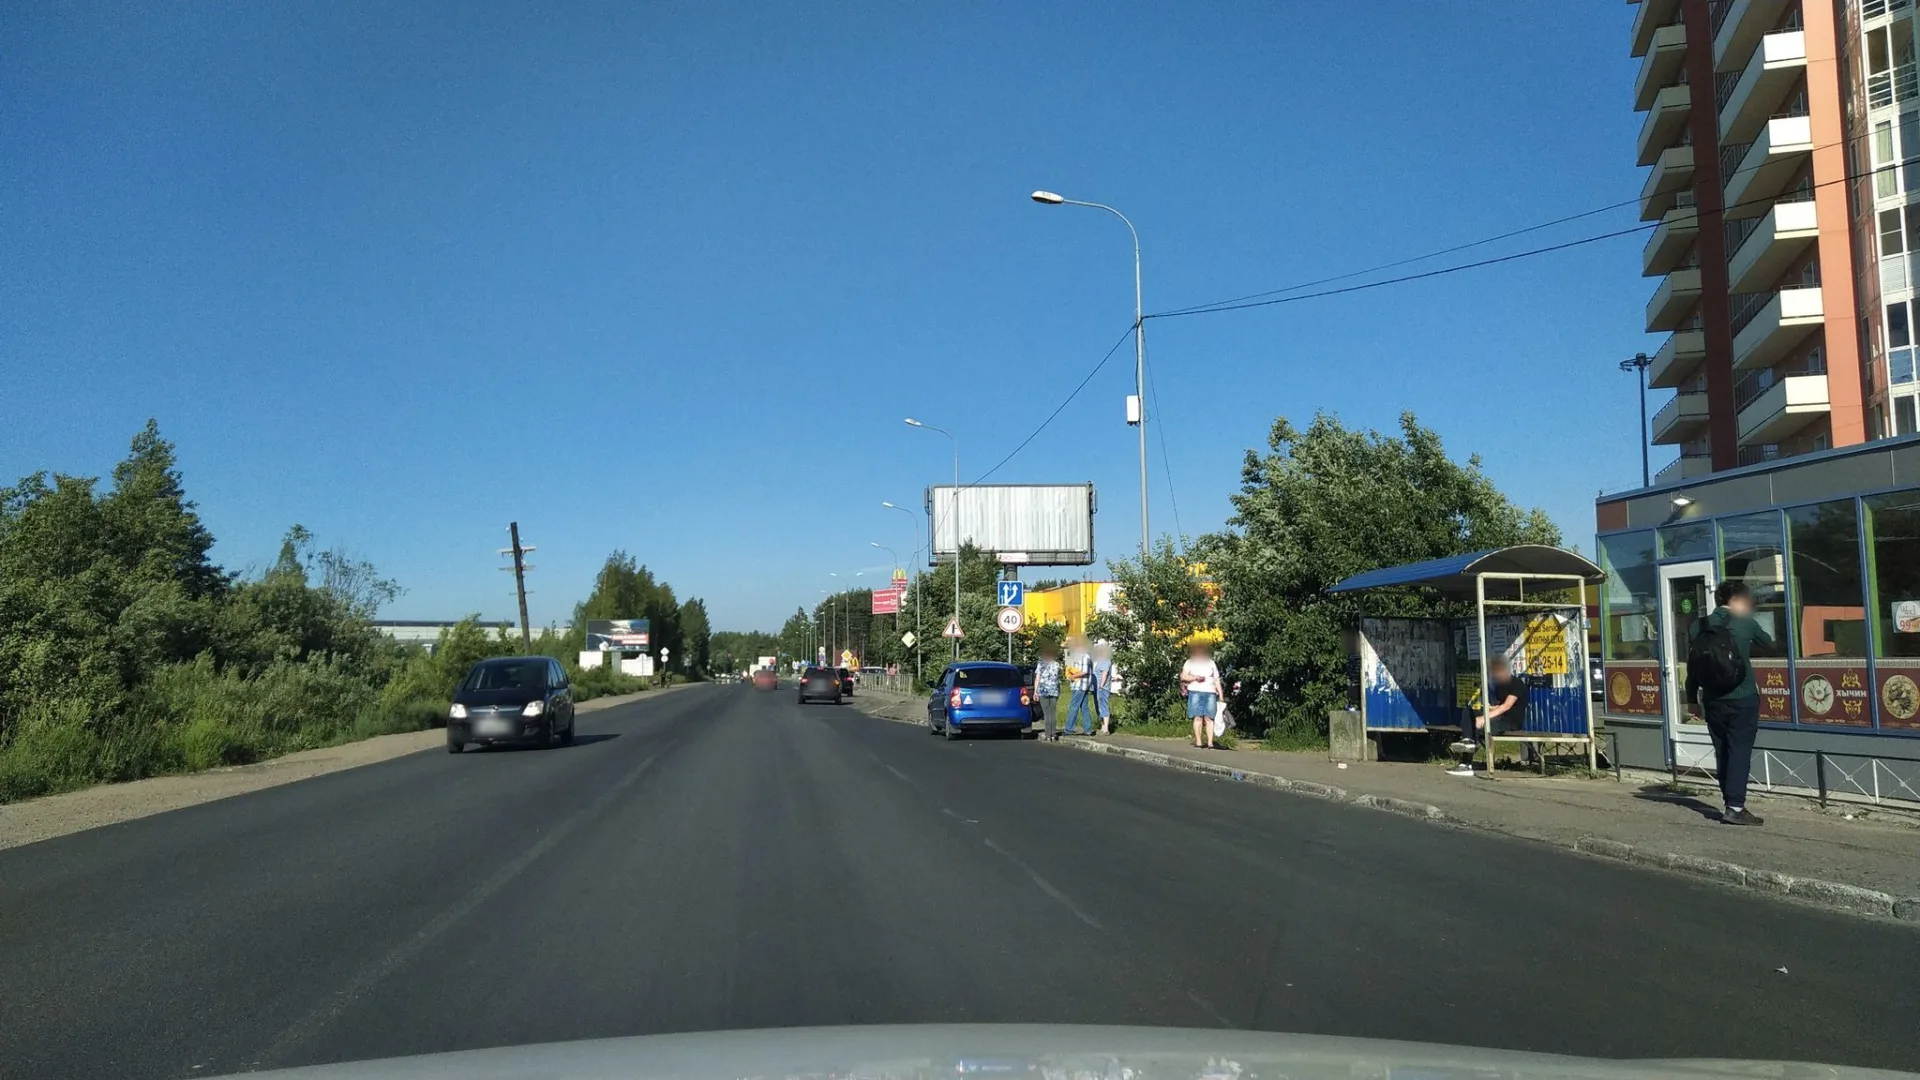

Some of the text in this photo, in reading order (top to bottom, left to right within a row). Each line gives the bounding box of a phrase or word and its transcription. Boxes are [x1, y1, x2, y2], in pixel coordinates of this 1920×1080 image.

[1004, 616, 1017, 624] 40
[1761, 687, 1790, 695] манты
[1836, 689, 1867, 697] хычин
